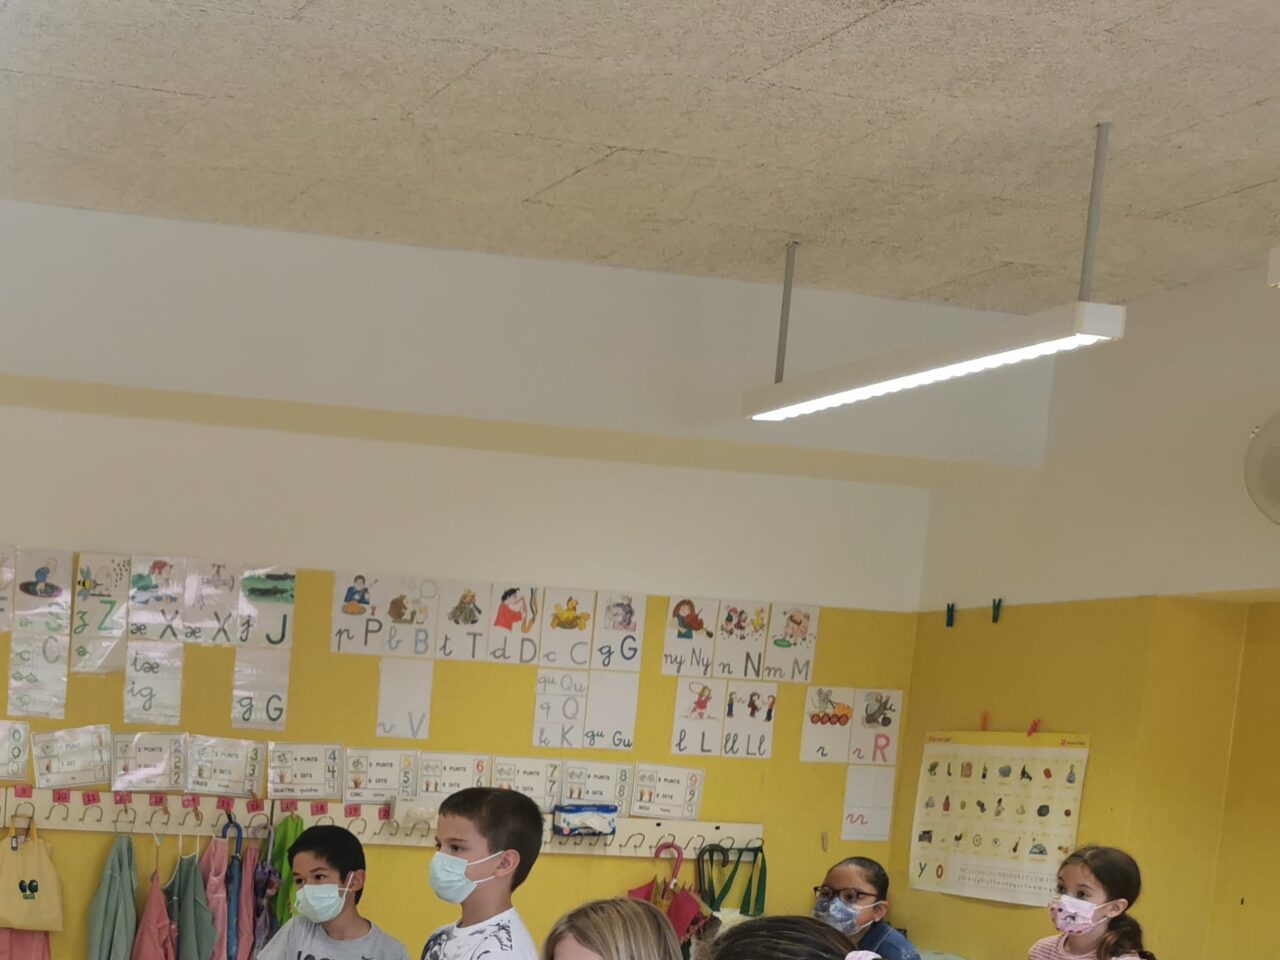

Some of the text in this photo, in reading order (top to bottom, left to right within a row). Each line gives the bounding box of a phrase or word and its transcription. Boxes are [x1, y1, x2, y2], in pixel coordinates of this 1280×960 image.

[98, 600, 116, 631] Z
[160, 609, 179, 639] X
[212, 611, 232, 642] X
[266, 614, 287, 645] J
[335, 618, 383, 652] p P
[386, 627, 429, 655] b B
[440, 632, 483, 659] t T
[490, 636, 537, 663] d D
[570, 641, 588, 665] C
[597, 635, 638, 667] g G
[664, 647, 712, 675] ny Ny
[719, 652, 761, 677] n N
[764, 658, 811, 681] m M
[127, 681, 157, 711] ig
[237, 694, 283, 722] g G
[562, 697, 579, 721] Q
[378, 711, 426, 739] v V
[561, 724, 575, 748] K
[584, 729, 633, 748] gu Gu
[675, 729, 712, 752] l L
[723, 733, 767, 756] ll Ll
[872, 733, 890, 762] R
[11, 746, 21, 758] 0
[250, 747, 259, 761] 3
[328, 750, 337, 762] 4
[173, 771, 180, 784] 2
[248, 764, 256, 777] 3
[327, 765, 336, 778] 4
[402, 771, 410, 784] 5
[476, 760, 485, 773] 6
[549, 764, 558, 777] 7
[619, 769, 627, 781] 8
[476, 775, 483, 788] 6
[548, 779, 556, 793] 7
[618, 784, 625, 797] 8
[689, 775, 698, 787] 9
[57, 792, 67, 800] 10
[87, 793, 96, 802] 11
[688, 789, 695, 802] 9
[349, 807, 358, 815] 19
[686, 803, 693, 816] 9
